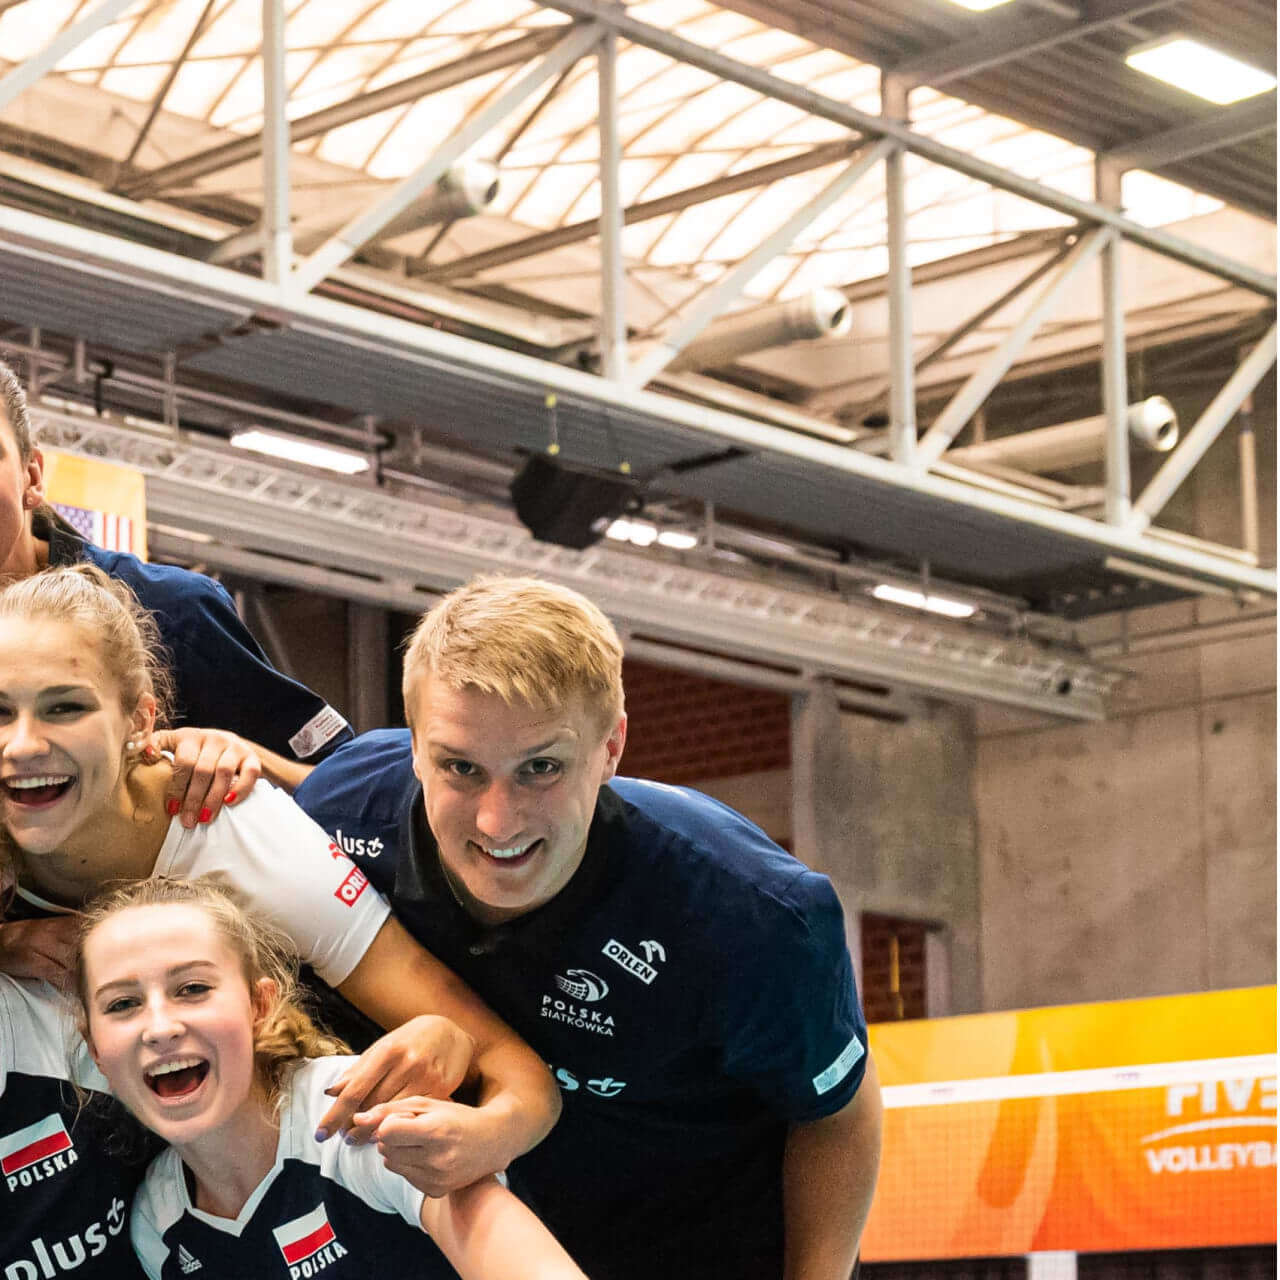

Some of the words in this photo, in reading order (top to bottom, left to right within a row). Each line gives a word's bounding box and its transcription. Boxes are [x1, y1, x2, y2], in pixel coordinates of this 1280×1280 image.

[331, 829, 365, 856] lus
[607, 943, 654, 981] ORLEN
[542, 994, 615, 1027] POLSKA
[6, 1148, 80, 1193] POLSKA
